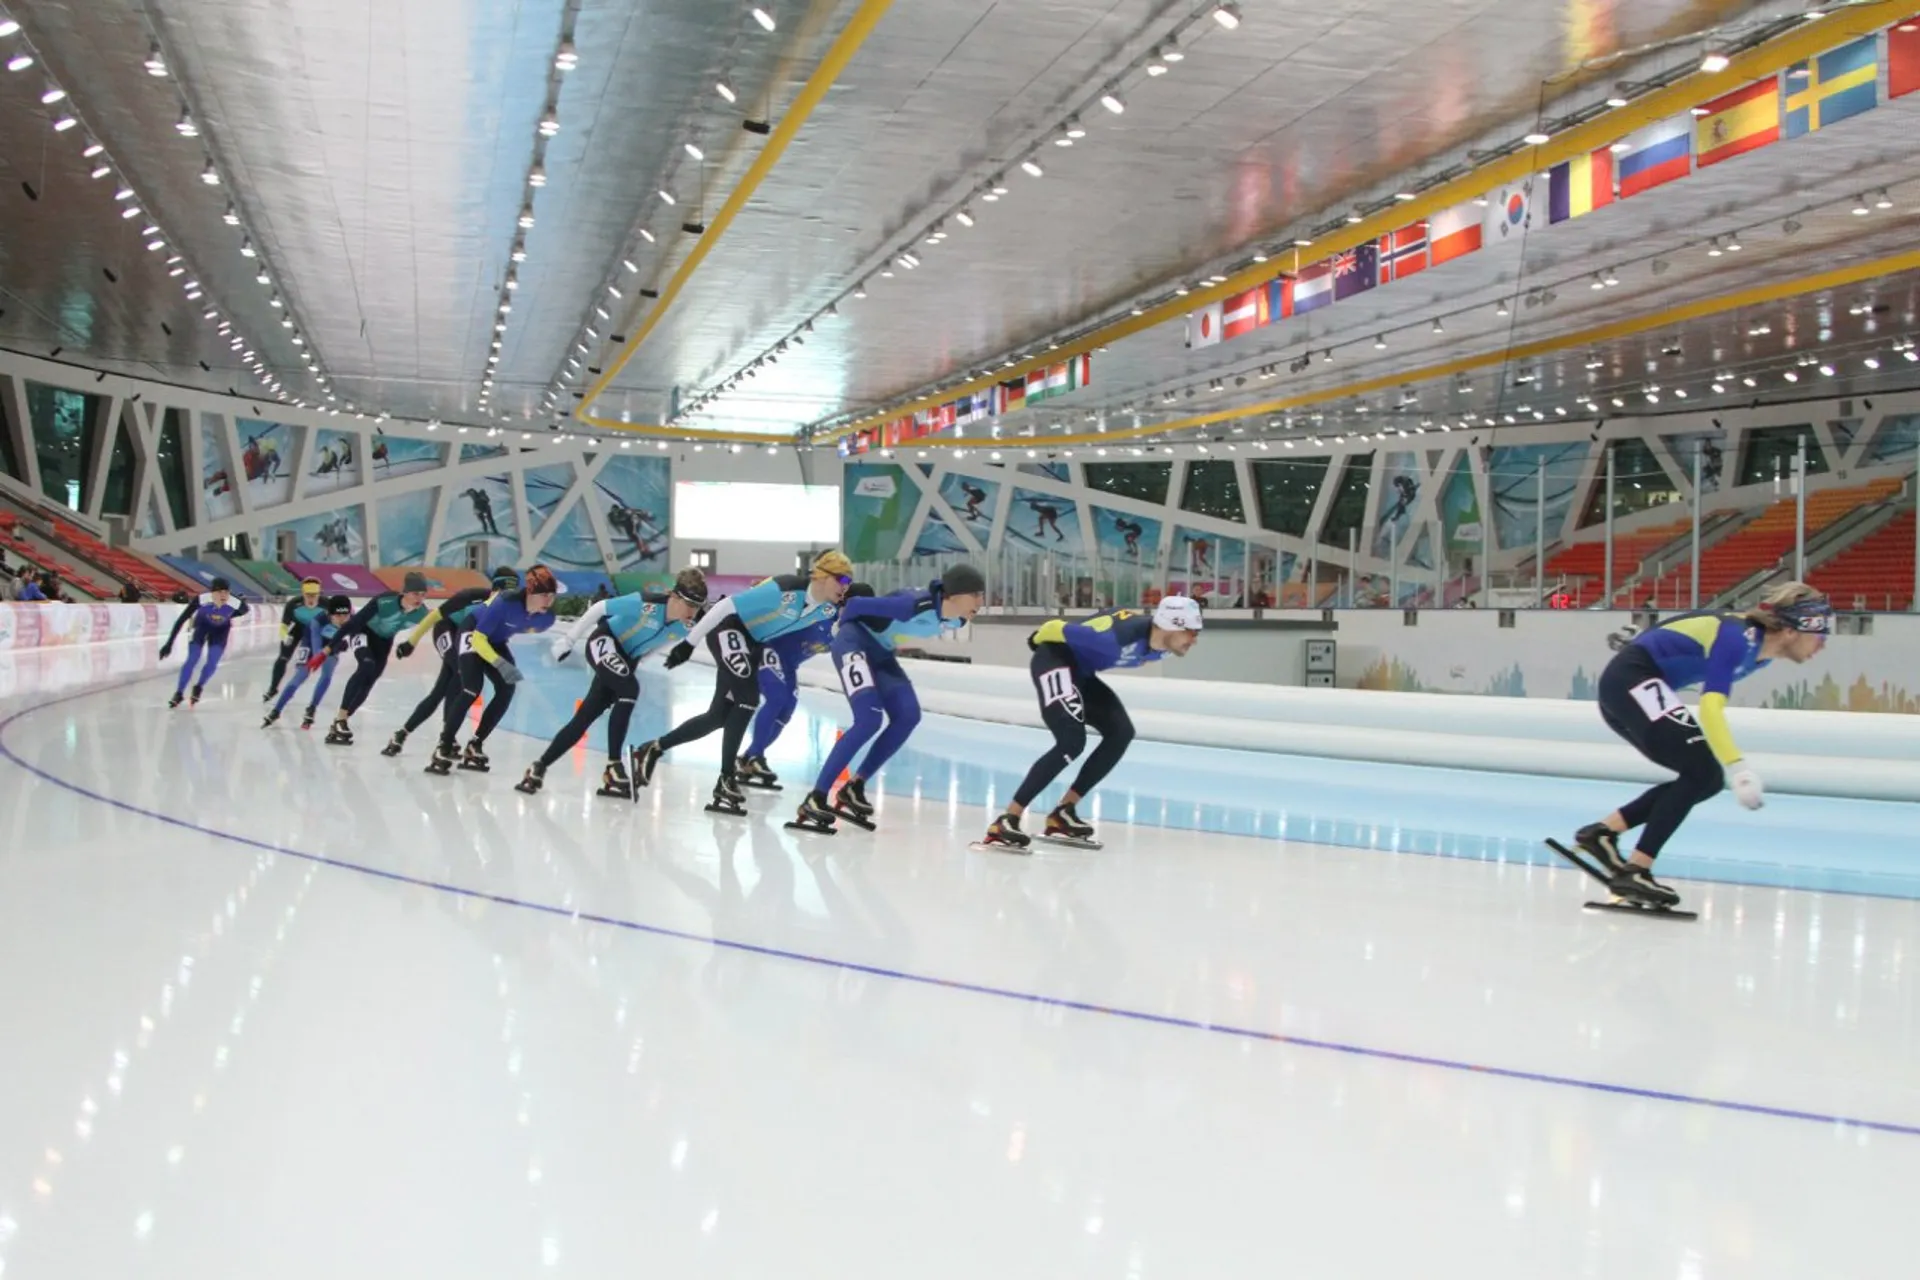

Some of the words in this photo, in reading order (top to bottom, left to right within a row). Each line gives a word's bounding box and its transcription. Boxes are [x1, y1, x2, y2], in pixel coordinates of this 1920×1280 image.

[596, 638, 607, 657] 2
[727, 631, 741, 652] 8
[766, 650, 777, 665] 6
[849, 664, 864, 688] 6
[1047, 671, 1064, 699] 11
[1643, 681, 1665, 711] 7
